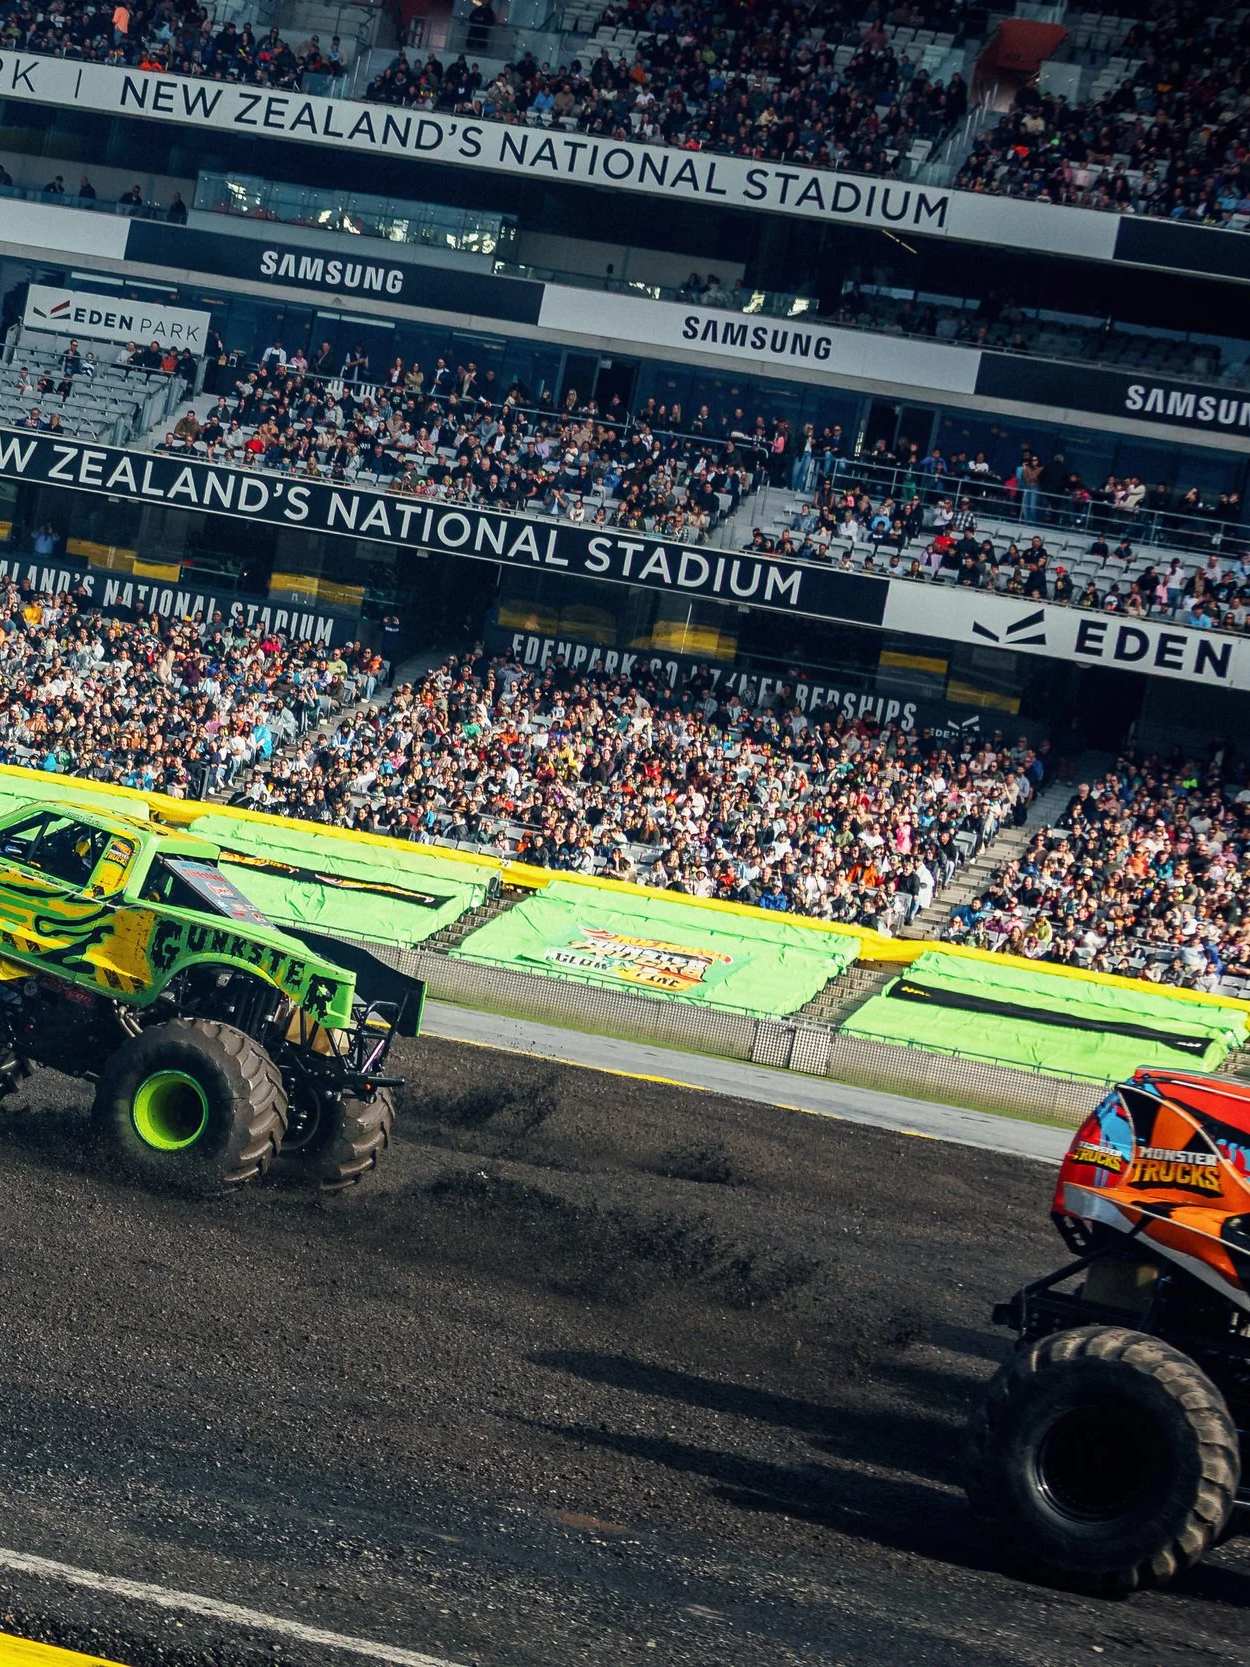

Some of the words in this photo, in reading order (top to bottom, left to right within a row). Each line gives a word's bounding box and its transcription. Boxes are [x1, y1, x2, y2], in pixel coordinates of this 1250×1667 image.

[120, 75, 221, 118] NEW
[234, 93, 483, 158] ZEALAND'S
[500, 133, 727, 196] NATIONAL
[742, 169, 950, 228] STADIUM
[260, 250, 404, 294] SAMSUNG
[74, 306, 134, 332] EDEN
[139, 317, 200, 345] PARK
[682, 315, 833, 361] SAMSUNG
[48, 444, 309, 522] ZEALAND'S
[327, 493, 569, 567] NATIONAL
[585, 536, 803, 605] STADIUM
[103, 579, 217, 623] NATIONAL
[228, 602, 334, 647] STADIUM
[1075, 620, 1233, 678] EDEN
[151, 919, 338, 1022] GUNKSTER
[1072, 1147, 1122, 1172] TRUCKS
[1129, 1160, 1222, 1194] TRUCKS
[1139, 1146, 1217, 1166] MONSTER
